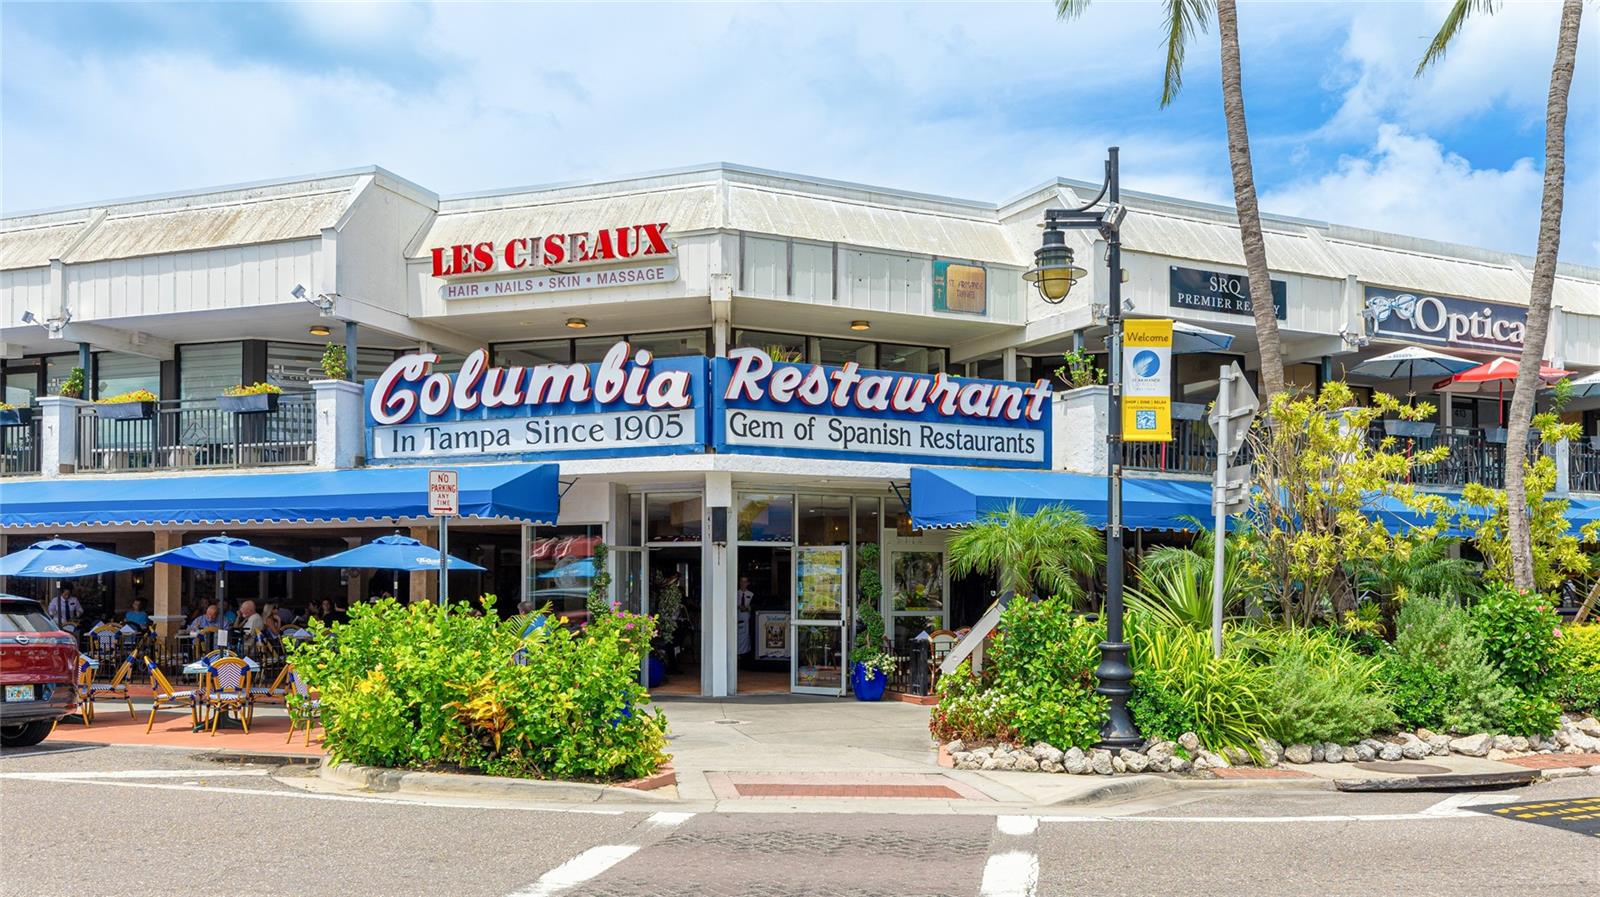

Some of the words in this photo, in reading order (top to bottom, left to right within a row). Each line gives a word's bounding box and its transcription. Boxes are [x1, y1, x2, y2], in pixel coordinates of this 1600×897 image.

[431, 242, 495, 277] LES
[504, 222, 670, 269] CISEAUX
[448, 285, 480, 298] HAIR
[495, 279, 533, 294] NAILS
[548, 275, 581, 289] SKIN
[597, 267, 665, 285] MASSAGE
[1209, 276, 1246, 299] SRQ
[1177, 292, 1232, 309] PREMIER
[1236, 300, 1281, 315] REY
[1415, 296, 1528, 344] Optica
[1126, 332, 1169, 342] Welcome
[369, 340, 692, 425] Columbia
[724, 346, 1053, 422] Restaurant
[391, 429, 415, 452] In
[424, 426, 510, 452] Tampa
[525, 419, 604, 445] Since
[614, 413, 684, 441] 1905
[729, 411, 784, 440] Gem
[794, 417, 817, 440] of
[828, 418, 911, 449] Spanish
[919, 425, 1035, 454] Restaurants
[432, 484, 456, 493] PARKING
[438, 474, 449, 483] NO
